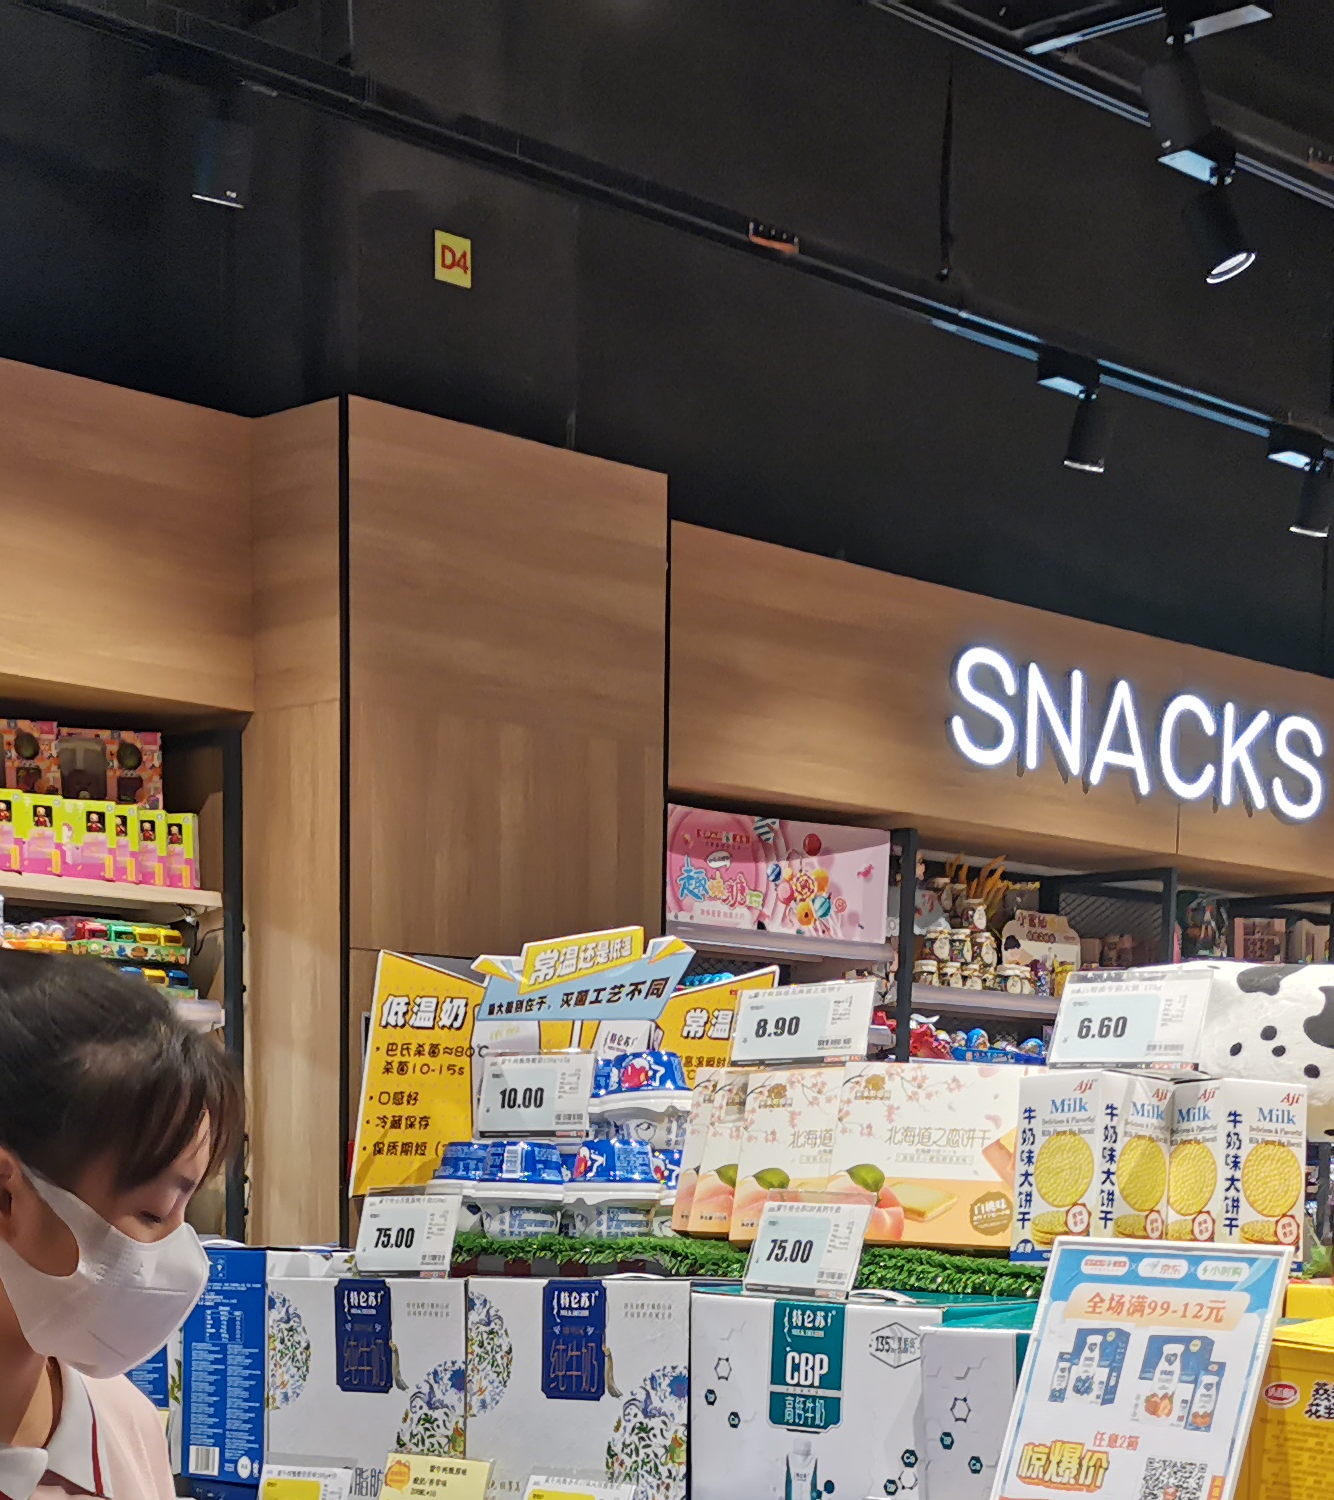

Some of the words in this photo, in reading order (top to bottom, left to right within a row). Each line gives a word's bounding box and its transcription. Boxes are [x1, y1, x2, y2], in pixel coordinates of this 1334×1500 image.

[441, 244, 468, 275] D4
[952, 647, 1323, 818] SNACKS
[380, 995, 468, 1030] 低温奶
[755, 1016, 800, 1038] 8.90
[1077, 1016, 1127, 1039] 6.60
[378, 1091, 419, 1106] 口感好
[500, 1088, 544, 1109] 10.00
[1050, 1098, 1088, 1115] Milk
[1131, 1101, 1165, 1121] Milk
[1177, 1105, 1211, 1123] Milk
[1258, 1107, 1297, 1125] Milk
[375, 1115, 431, 1131] 冷藏保存
[886, 1127, 991, 1149] 北海道之恋饼干
[1017, 1107, 1036, 1231] 牛奶味大饼干
[1099, 1104, 1119, 1230] 牛奶味大饼干
[1223, 1110, 1243, 1236] 牛奶味大饼干
[374, 1227, 415, 1249] 75.00
[765, 1239, 813, 1263] 75.00
[1085, 1292, 1226, 1323] 全场满99-12元
[792, 1310, 832, 1329] 特仑苏
[785, 1351, 829, 1386] CBP
[784, 1395, 826, 1427] 高钙牛奶
[1093, 1431, 1140, 1451] 任意2箱
[1018, 1440, 1109, 1488] 惊爆价
